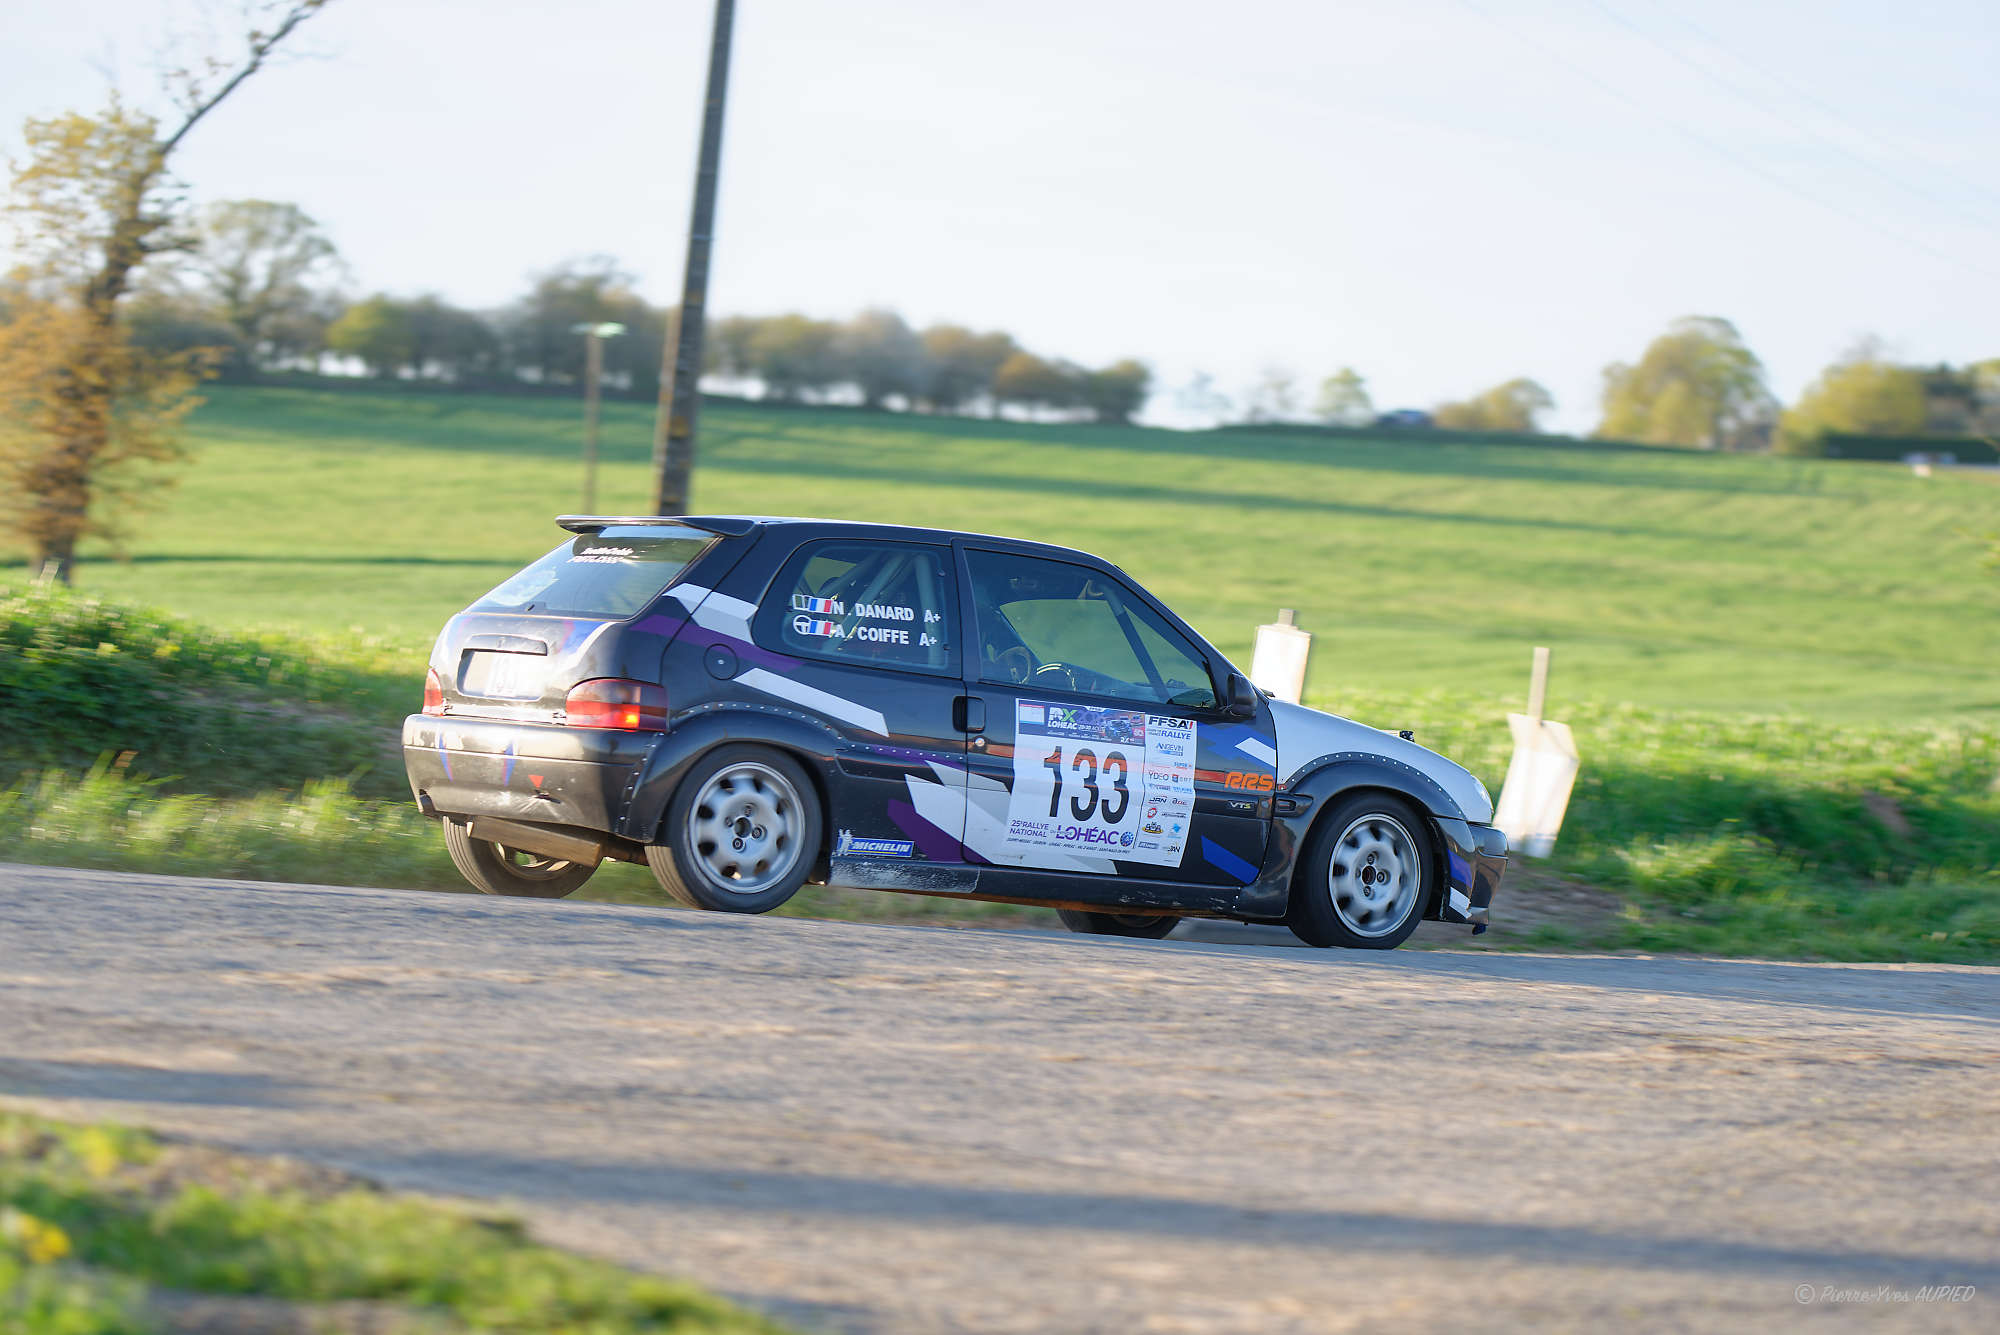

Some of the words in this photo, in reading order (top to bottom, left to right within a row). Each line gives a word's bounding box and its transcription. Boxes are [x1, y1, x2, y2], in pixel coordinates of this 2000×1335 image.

[855, 602, 915, 621] DANARD
[923, 609, 942, 623] A+
[857, 626, 910, 645] COIFFE
[919, 632, 938, 646] A+
[1048, 707, 1078, 723] RX
[1047, 720, 1078, 730] LOHEAC
[1148, 716, 1189, 730] FFSA
[1161, 730, 1192, 740] RALLYE
[1043, 745, 1130, 824] 133
[1224, 772, 1274, 792] RRS
[1230, 801, 1251, 809] VTS
[1022, 821, 1049, 830] RALLYE
[1009, 828, 1047, 838] NATIONAL
[1056, 825, 1119, 845] LOHÉAC
[852, 841, 912, 852] MICHELIN
